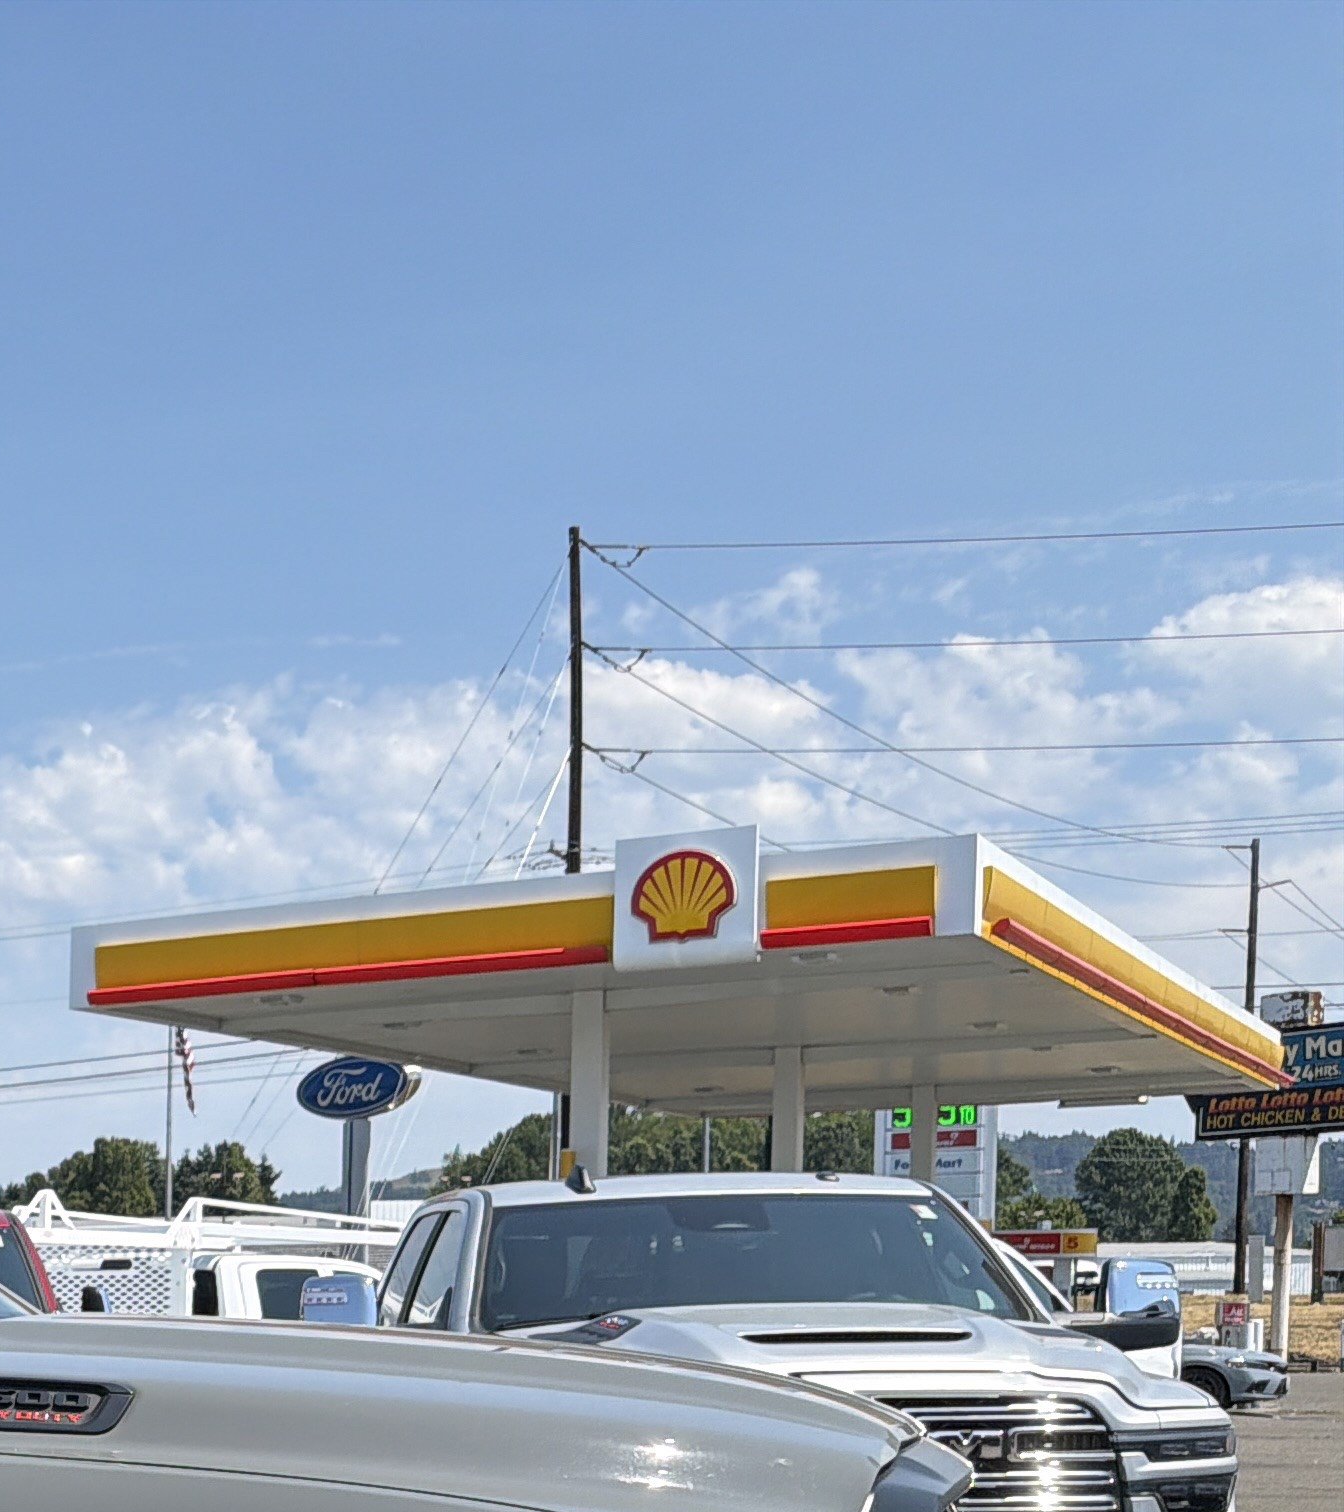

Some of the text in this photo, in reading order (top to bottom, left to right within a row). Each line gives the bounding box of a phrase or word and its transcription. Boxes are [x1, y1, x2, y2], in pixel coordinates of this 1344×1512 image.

[316, 1066, 382, 1107] Ford
[1206, 1113, 1236, 1130] HOT
[1240, 1107, 1306, 1127] CHICKEN
[1310, 1106, 1321, 1121] &
[1067, 1235, 1079, 1250] 5
[15, 1410, 84, 1424] DUTY
